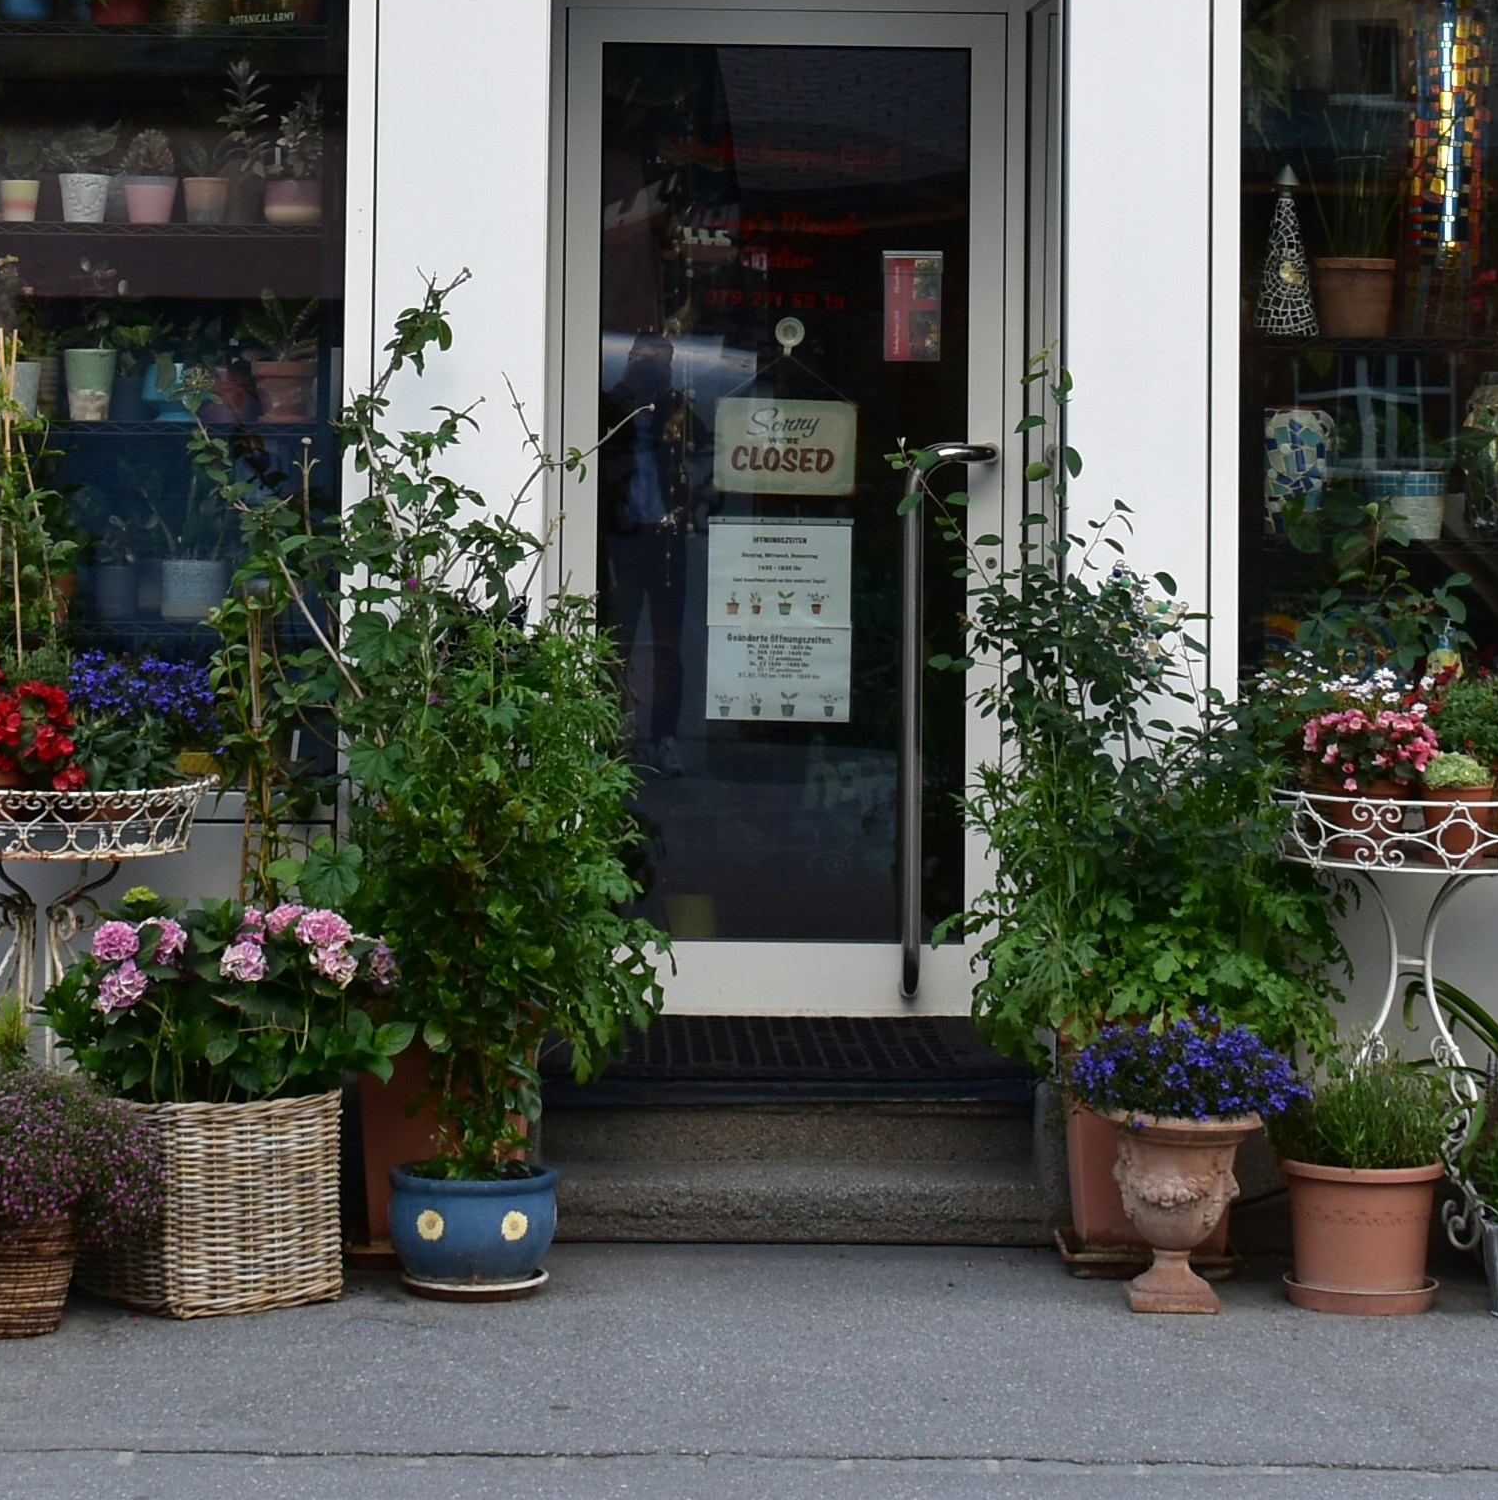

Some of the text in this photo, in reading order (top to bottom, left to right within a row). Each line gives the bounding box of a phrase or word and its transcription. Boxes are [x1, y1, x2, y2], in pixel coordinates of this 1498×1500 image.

[229, 11, 296, 25] BOTANICAL ARMY
[747, 407, 820, 438] Sorry
[731, 445, 835, 474] CLOSED
